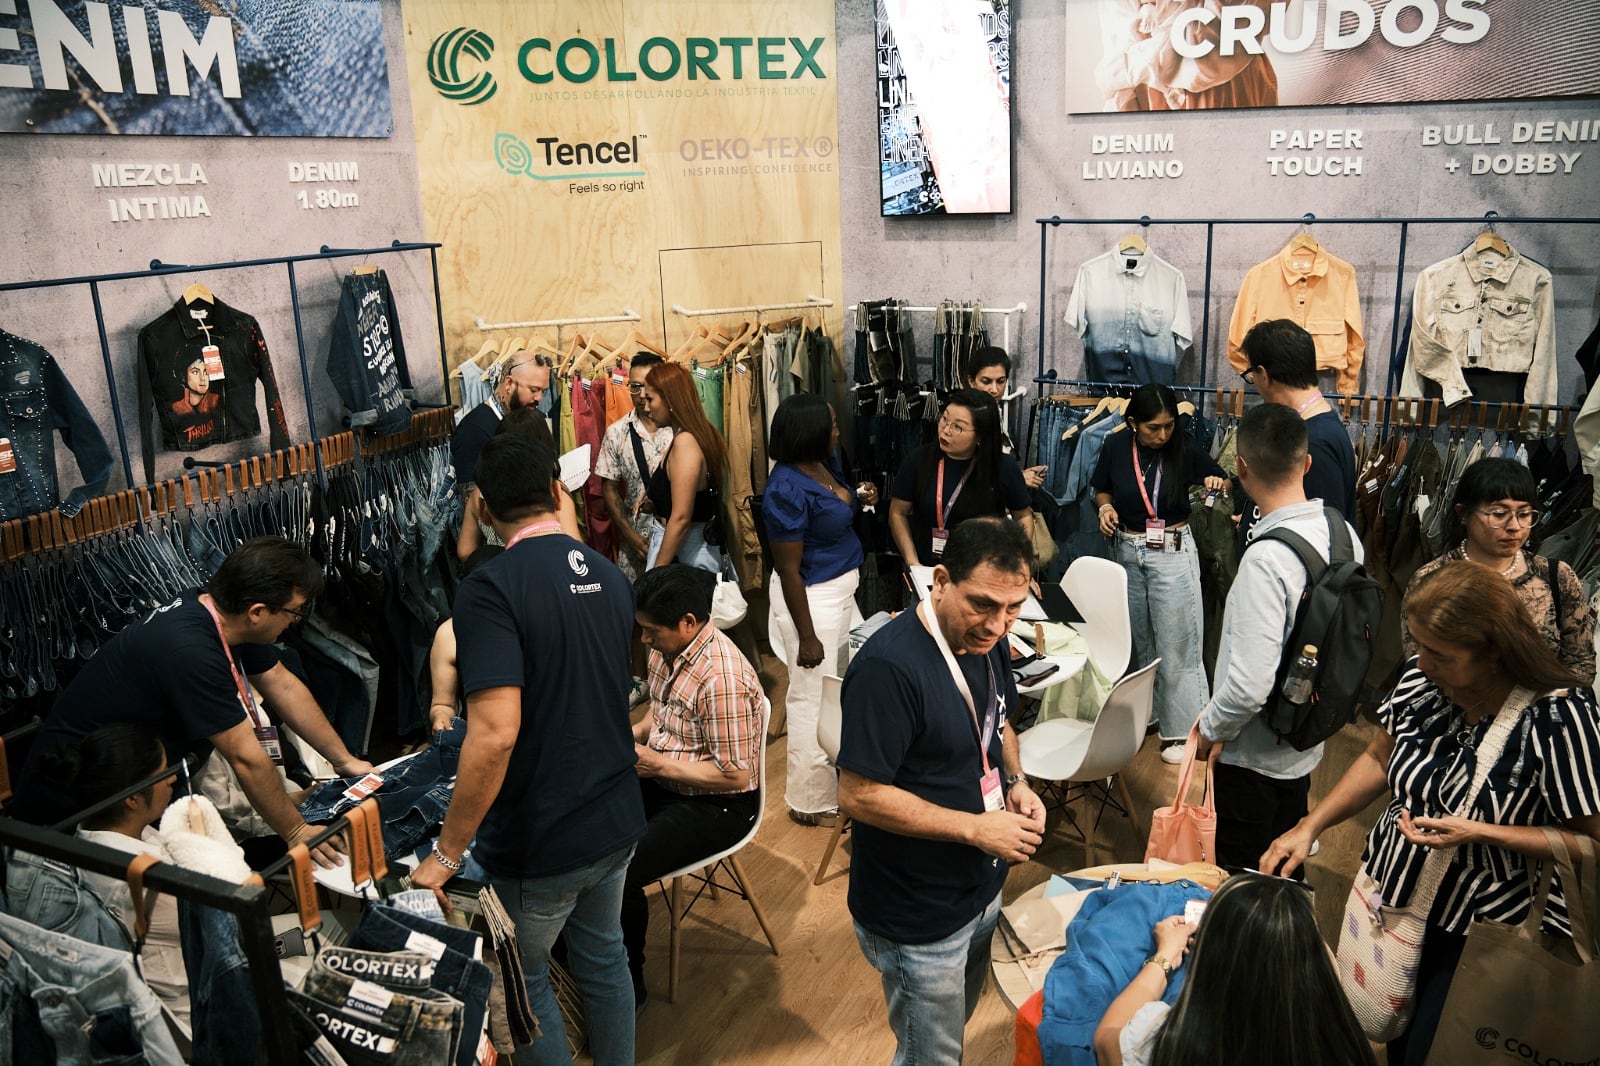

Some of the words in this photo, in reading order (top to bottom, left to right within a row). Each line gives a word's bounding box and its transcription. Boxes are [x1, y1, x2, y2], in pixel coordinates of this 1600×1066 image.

[1170, 0, 1491, 58] CRUDOS
[517, 37, 826, 84] COLORTEX
[530, 91, 578, 102] JUNTOS
[584, 89, 692, 100] DESARROLLANDO
[696, 88, 709, 97] LA
[714, 87, 778, 97] INDUSTRIA
[784, 86, 816, 96] TEXTIL
[1091, 134, 1174, 154] DENIM
[1269, 130, 1363, 151] PAPER
[1422, 123, 1500, 146] BULL
[288, 161, 359, 183] DENIM
[683, 166, 749, 177] INSPIRING
[754, 163, 833, 175] CONFIDENCE
[1082, 160, 1184, 180] LIVIANO
[1267, 156, 1363, 177] TOUCH
[1471, 152, 1582, 175] DOBBY
[92, 163, 208, 188] MEZCLA
[569, 183, 600, 194] Feels
[603, 183, 617, 192] so
[620, 180, 645, 193] right
[107, 196, 211, 222] INTIMA
[321, 954, 418, 979] OLORTEX
